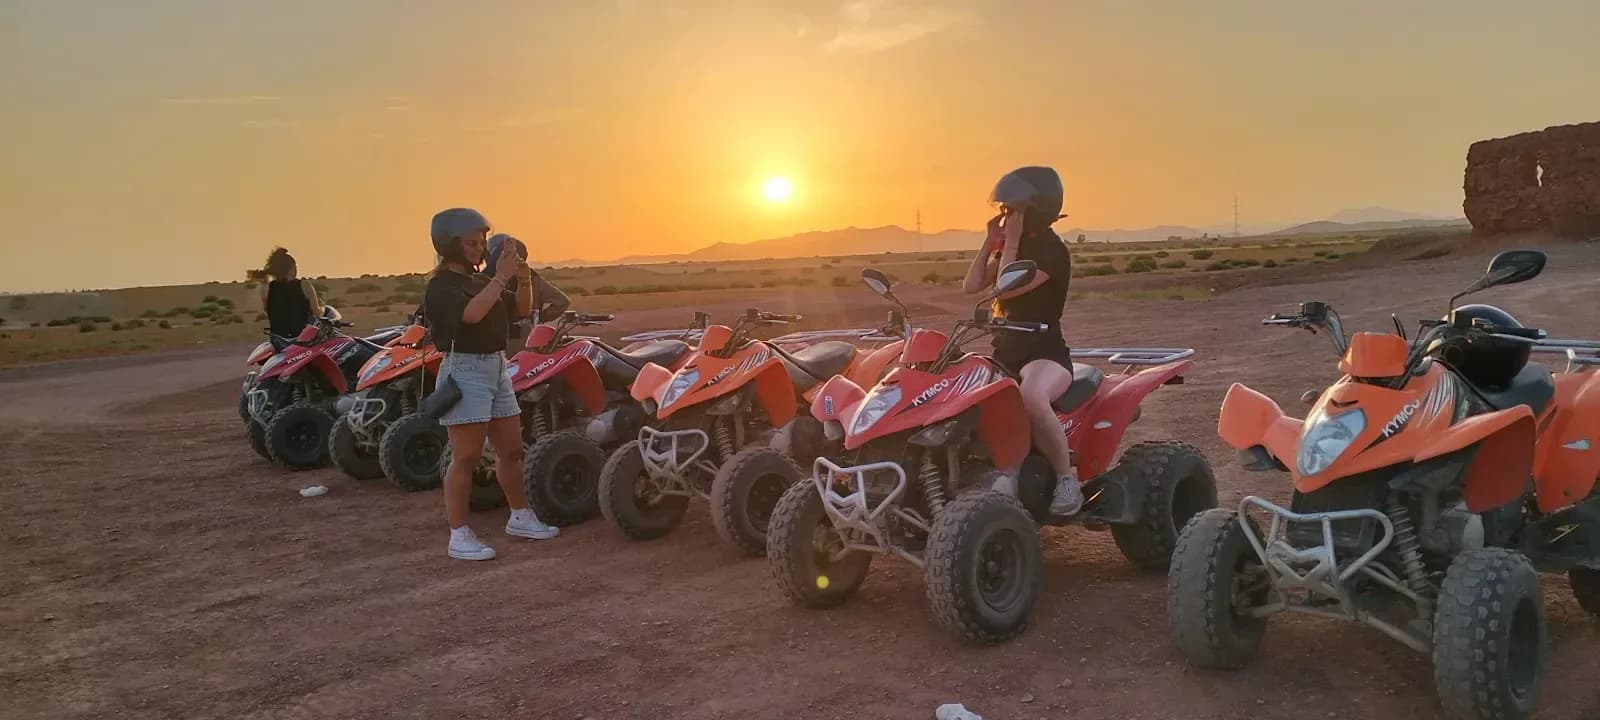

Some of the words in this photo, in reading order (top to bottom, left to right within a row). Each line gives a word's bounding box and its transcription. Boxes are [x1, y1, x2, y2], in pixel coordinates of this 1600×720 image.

[287, 350, 312, 364] KYMCO
[526, 358, 554, 378] KYMCO
[707, 363, 735, 386] KYMCO
[911, 378, 949, 404] KYMCO
[1382, 399, 1419, 437] KYMCO
